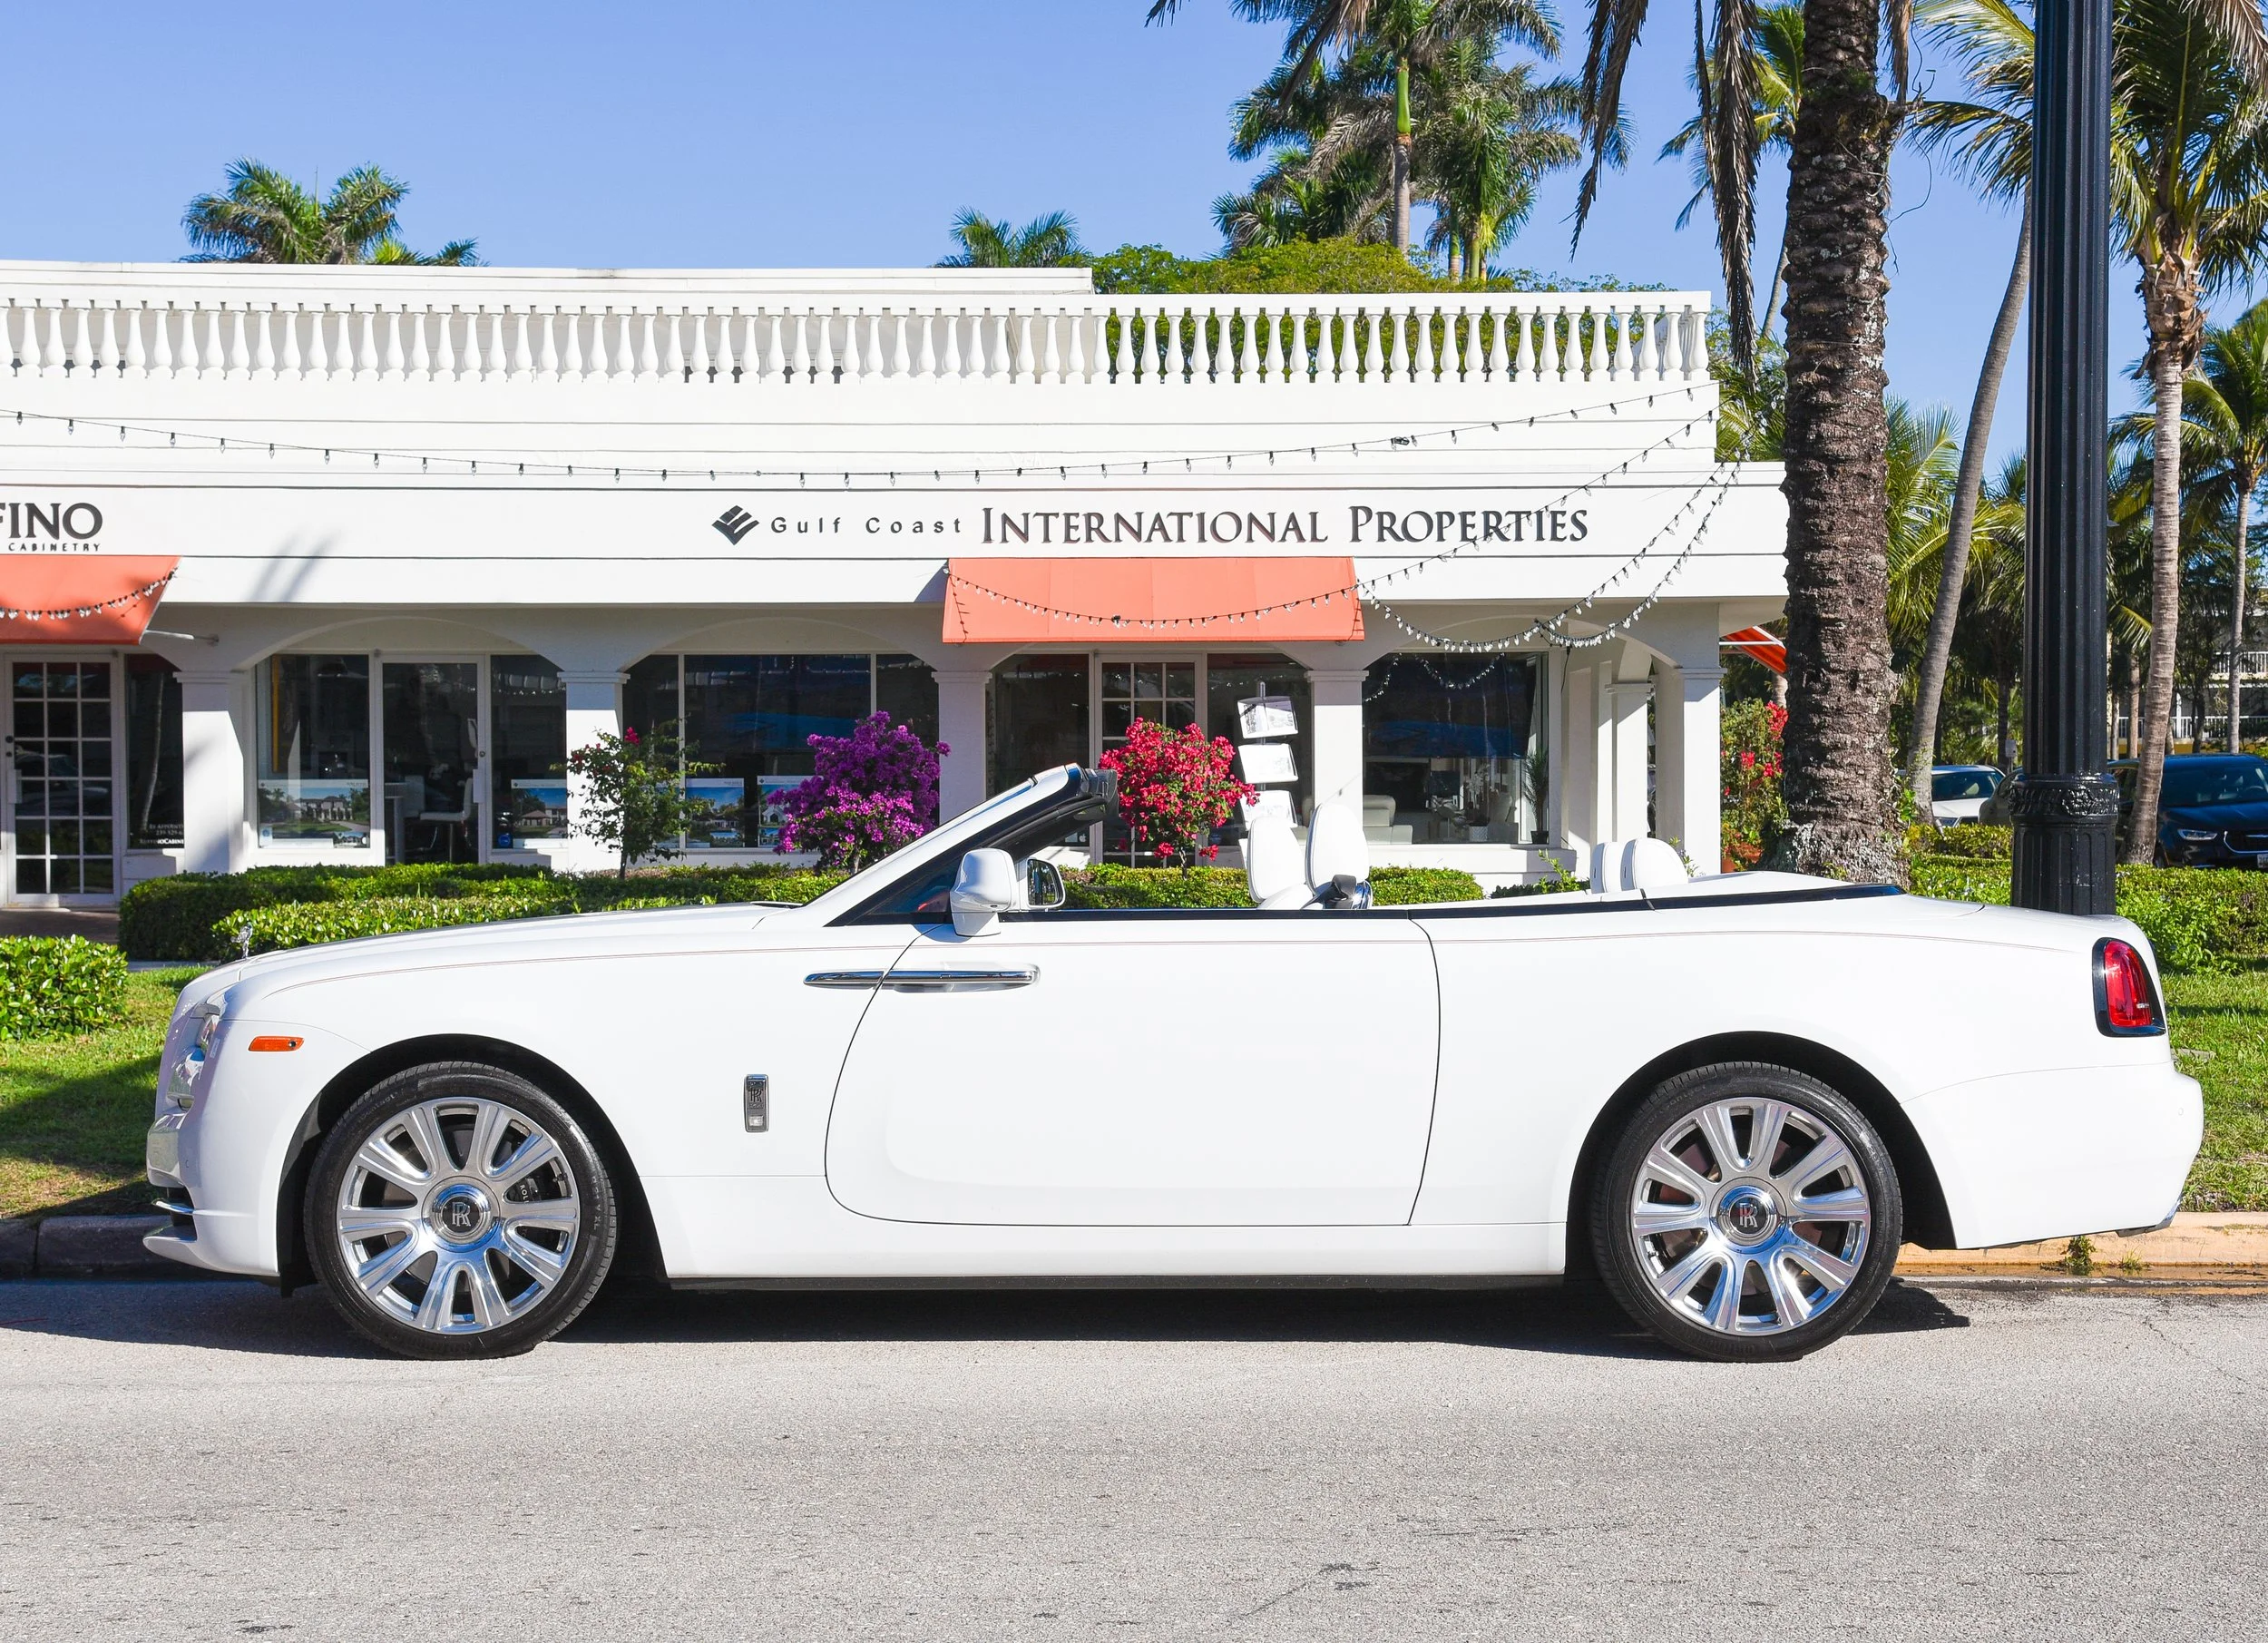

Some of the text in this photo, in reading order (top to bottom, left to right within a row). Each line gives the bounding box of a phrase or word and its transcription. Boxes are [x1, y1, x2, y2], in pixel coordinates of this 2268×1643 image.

[0, 502, 103, 541] INO
[770, 505, 1588, 544] Gulf Coast INTERNATIONAL PROPERTIES
[8, 543, 100, 552] CABINETRY
